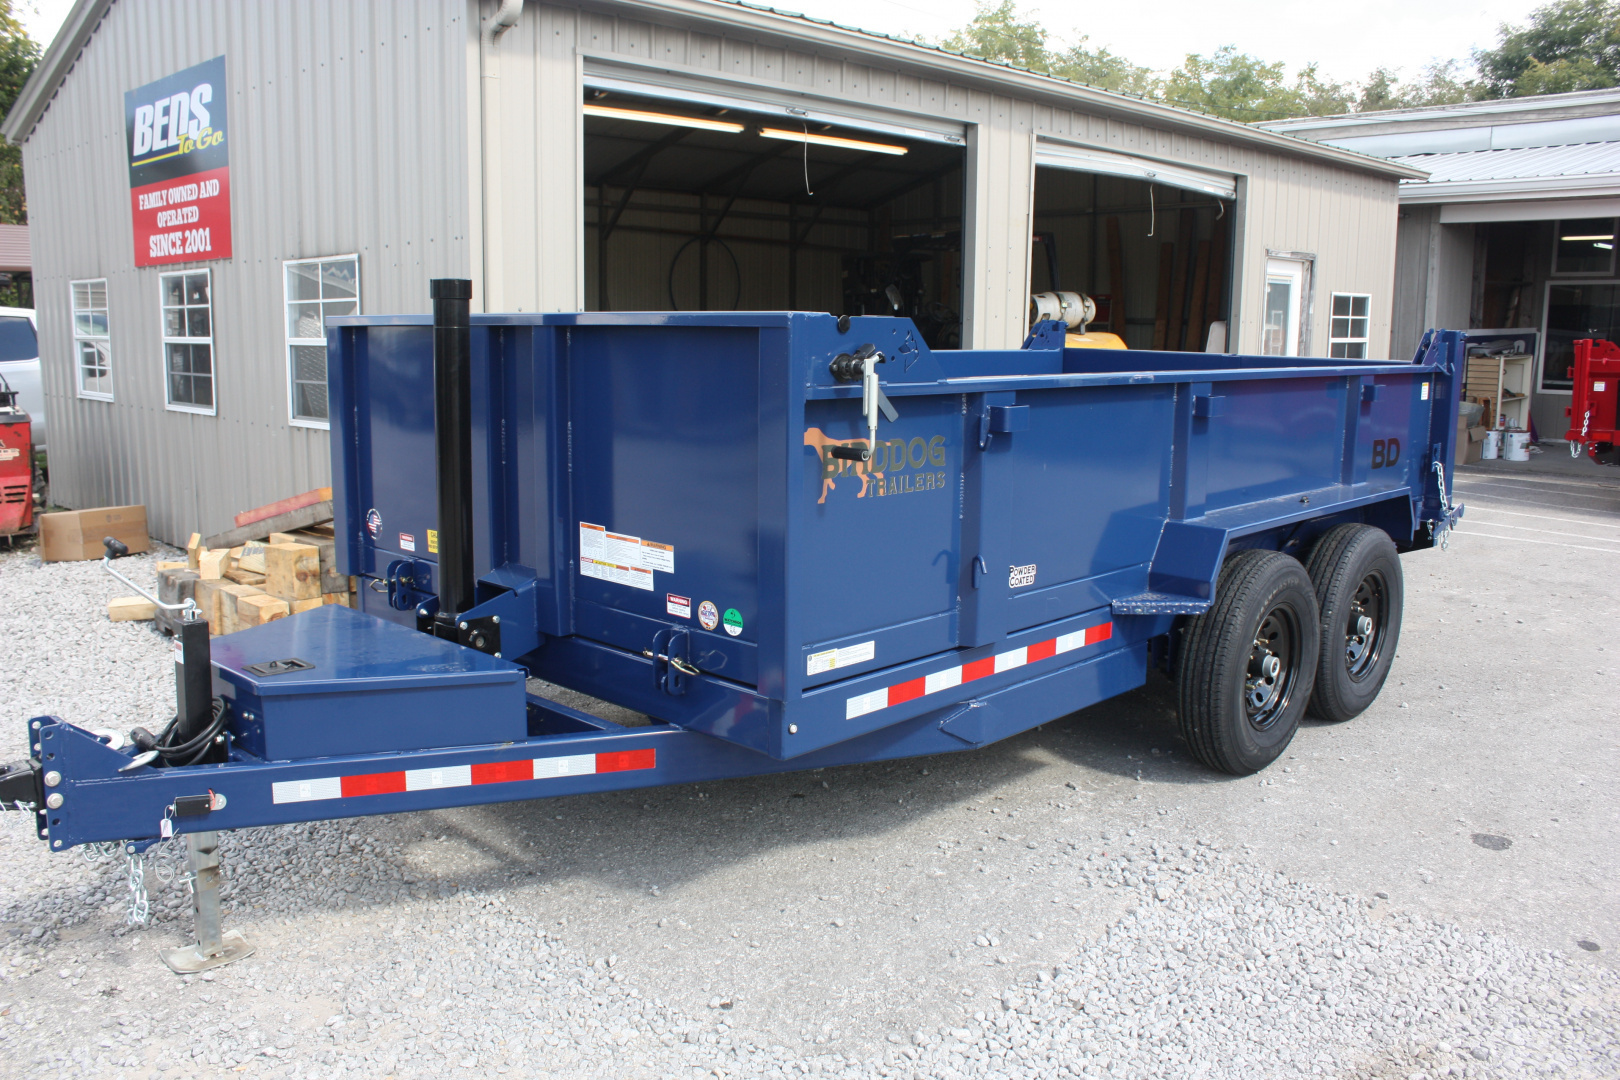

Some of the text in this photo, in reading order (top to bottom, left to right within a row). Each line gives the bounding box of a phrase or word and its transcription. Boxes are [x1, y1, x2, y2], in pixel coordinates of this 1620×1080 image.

[133, 83, 212, 156] BEDS
[177, 126, 224, 155] To Go
[138, 178, 220, 210] FAMILY OWNED AND
[157, 205, 199, 228] OPERATED
[149, 227, 212, 257] SINCE 2001
[1371, 437, 1400, 470] BD
[866, 471, 946, 498] TRAILERS
[1009, 564, 1035, 577] POWDER
[1009, 575, 1034, 587] COATED
